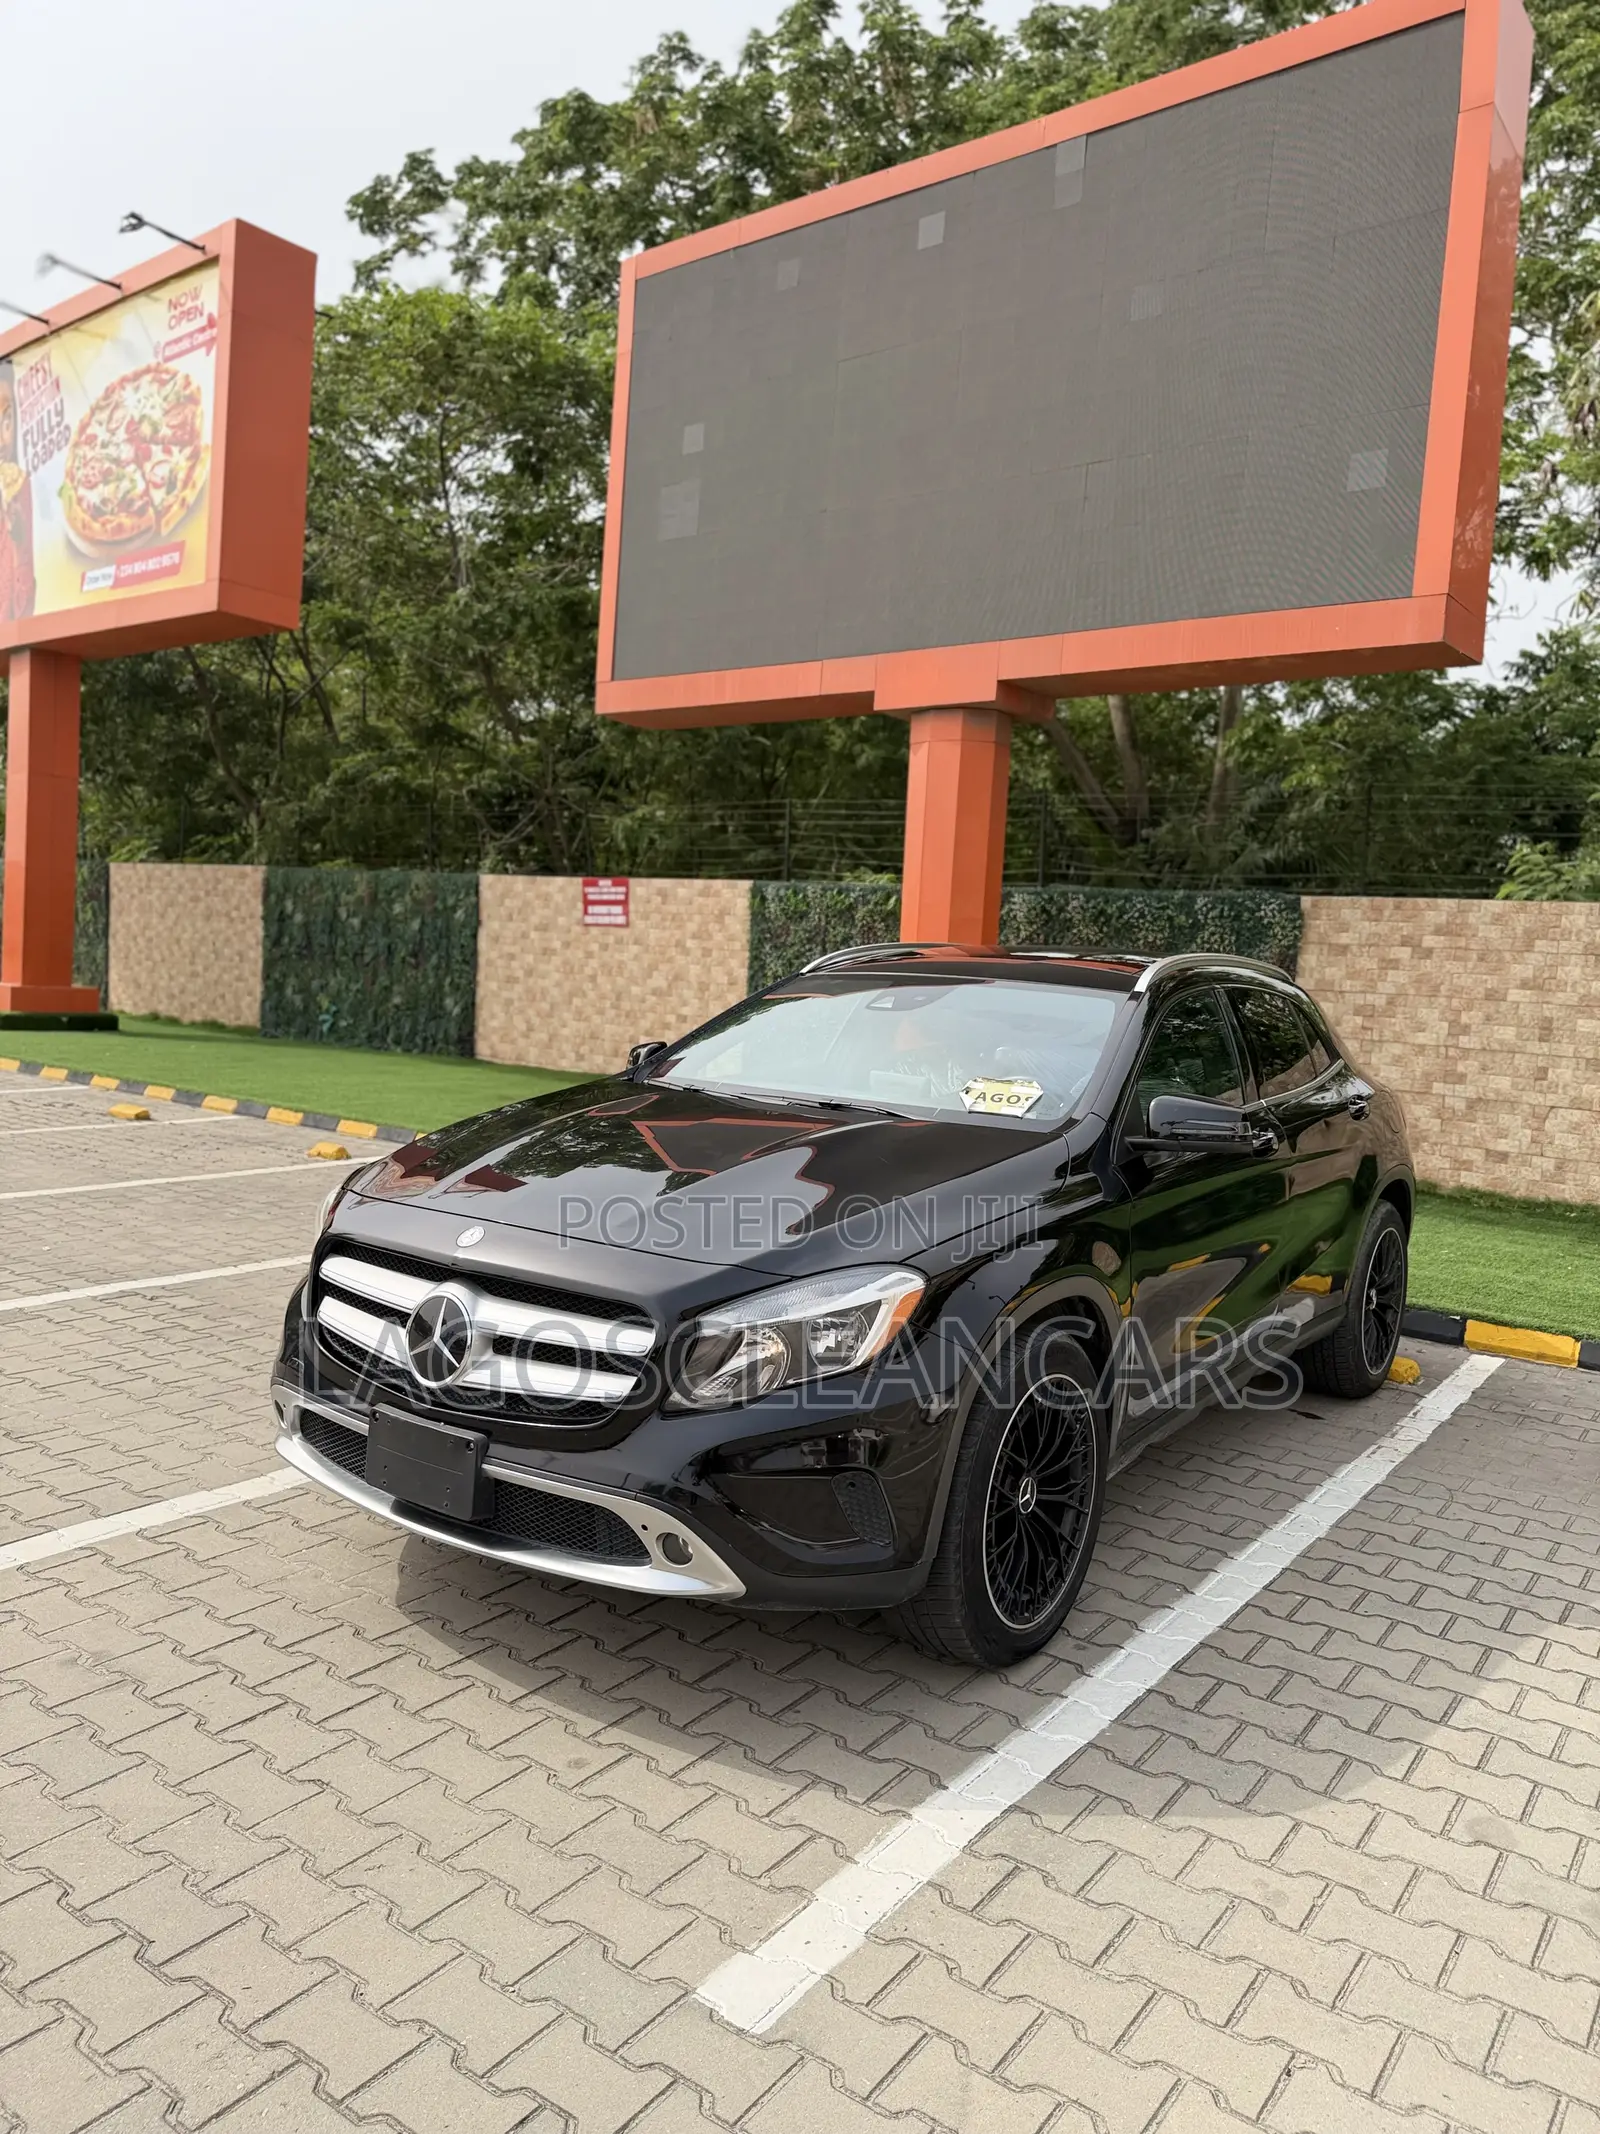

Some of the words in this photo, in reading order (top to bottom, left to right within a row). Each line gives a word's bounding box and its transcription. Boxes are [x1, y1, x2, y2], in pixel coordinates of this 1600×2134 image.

[167, 284, 203, 313] NOW
[168, 302, 204, 330] OPEN
[23, 397, 64, 459] FULLY
